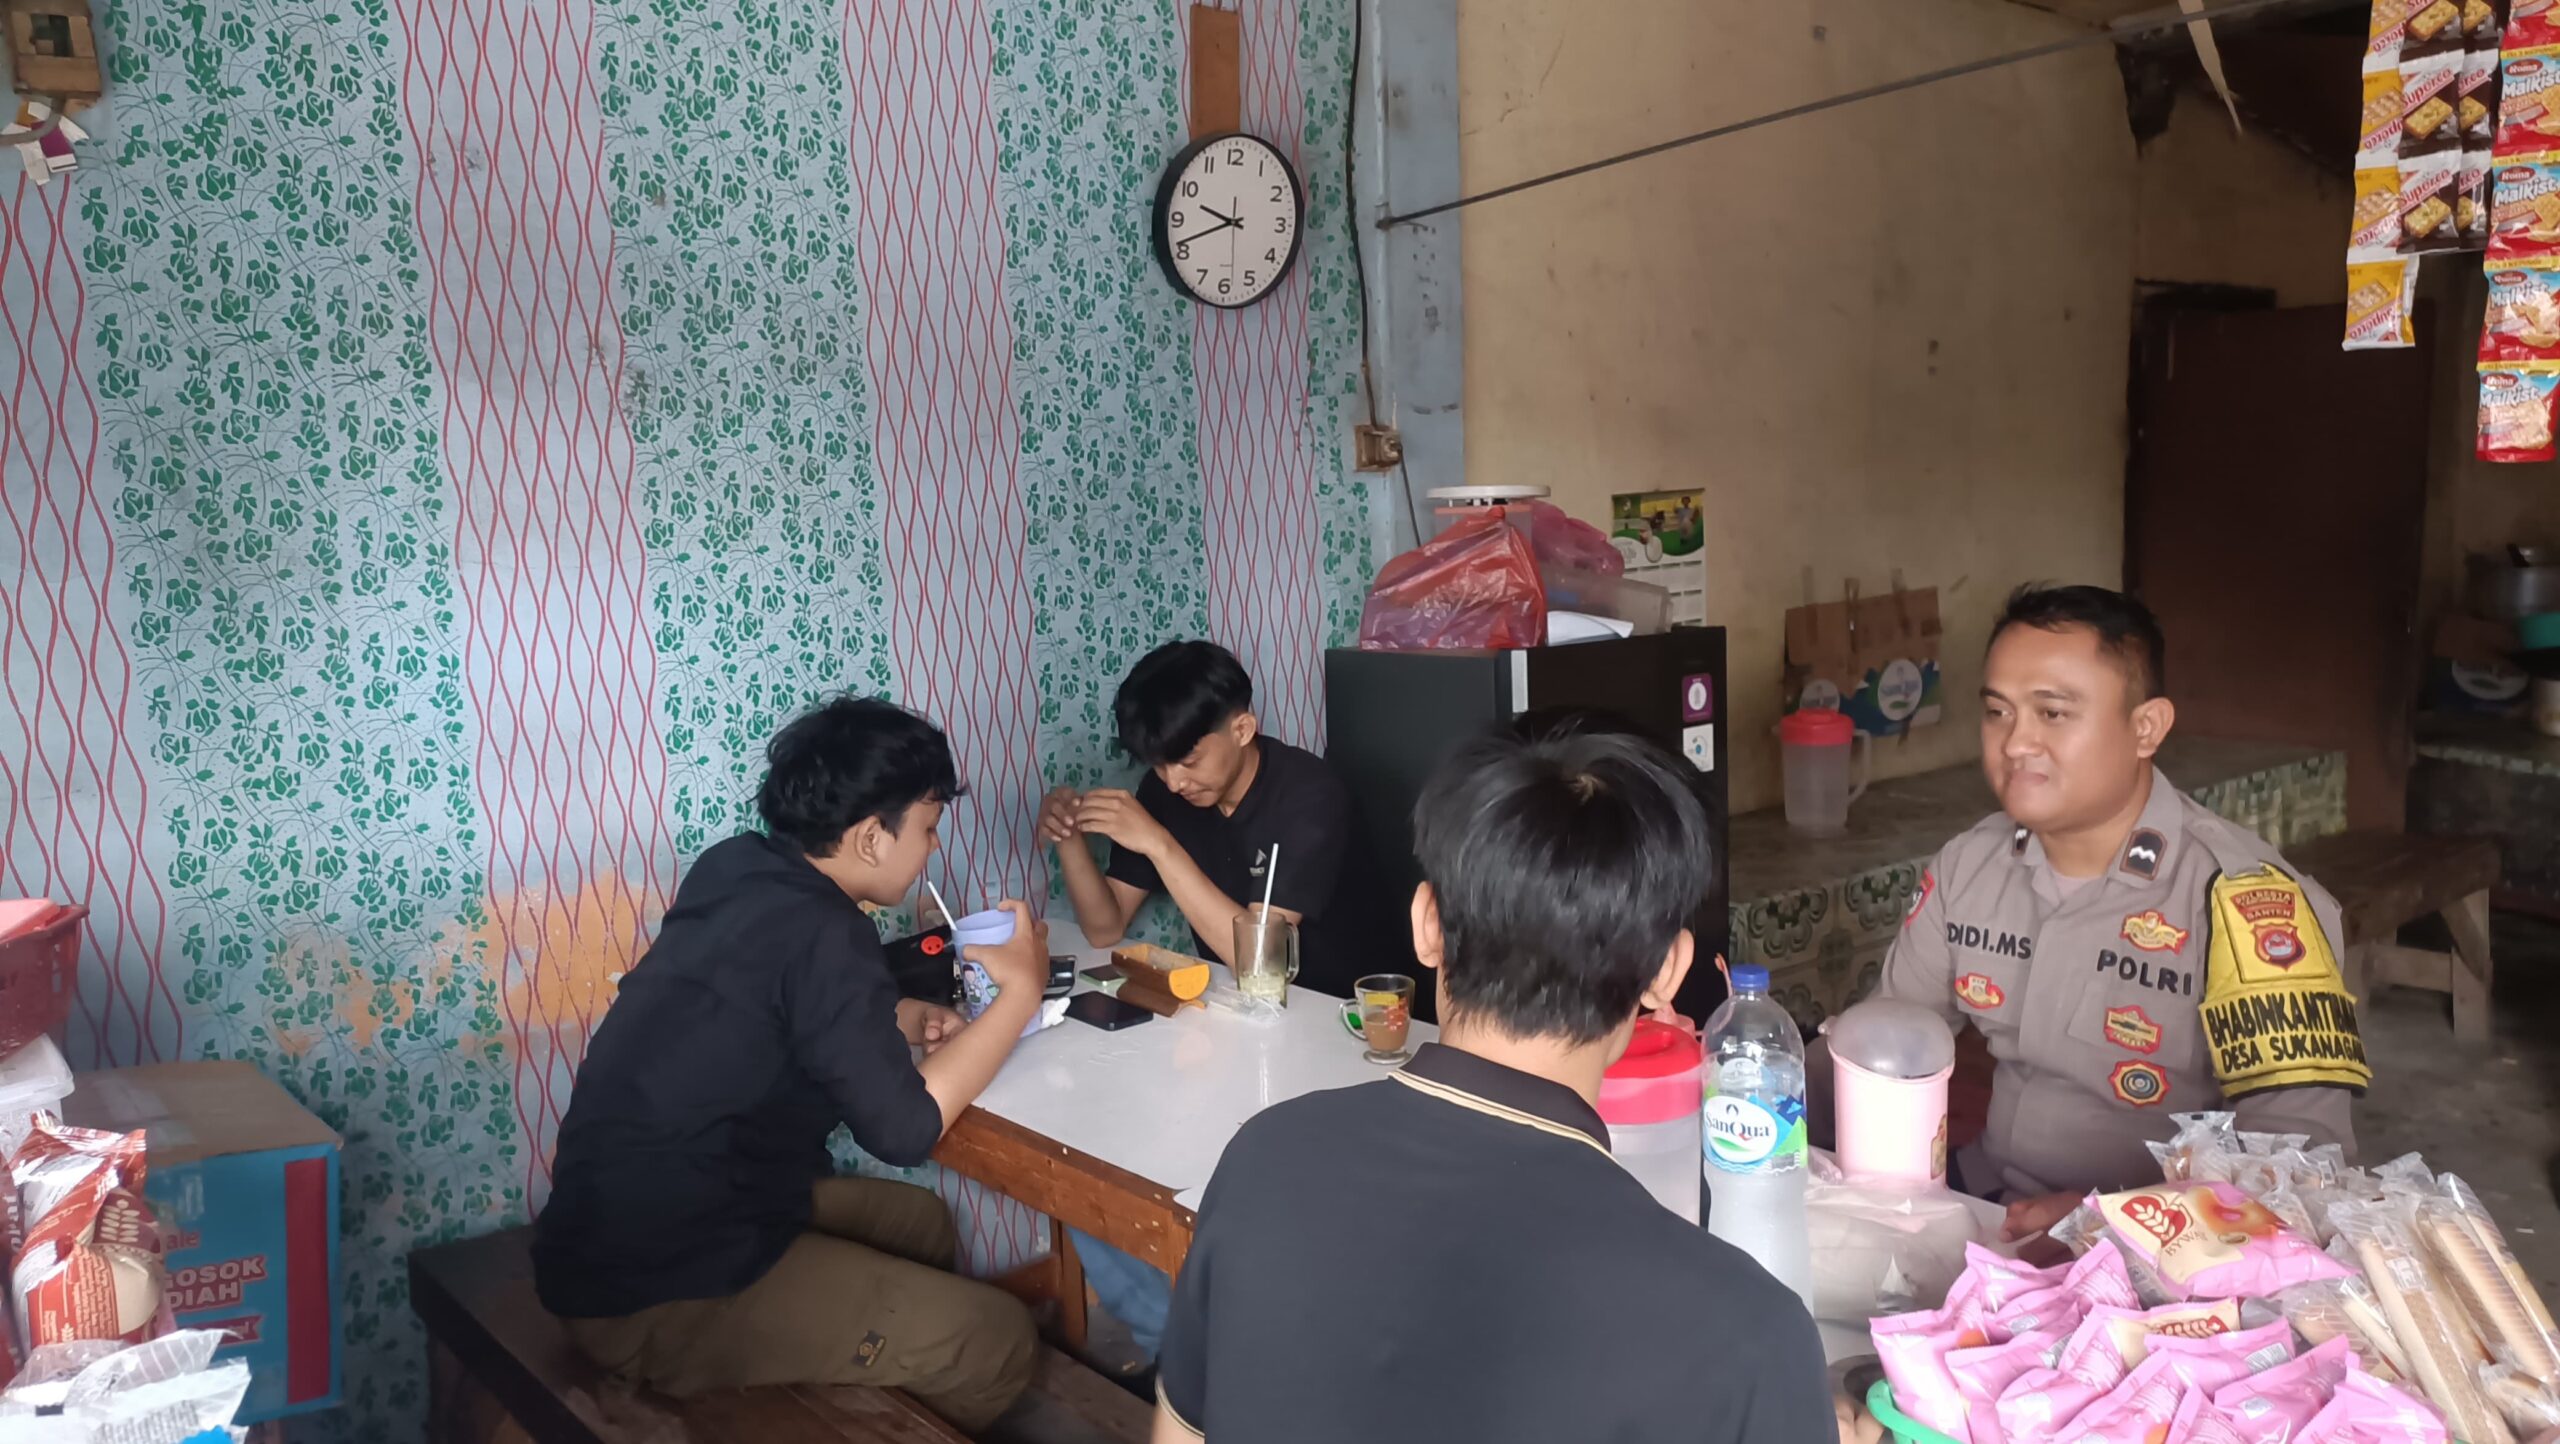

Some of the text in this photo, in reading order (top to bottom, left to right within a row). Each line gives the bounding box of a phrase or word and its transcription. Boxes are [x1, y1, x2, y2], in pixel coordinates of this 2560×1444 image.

[1205, 157, 1215, 174] 11
[1227, 149, 1244, 166] 12
[1258, 160, 1264, 177] 1
[1181, 181, 1199, 198] 10
[1270, 186, 1283, 202] 2
[1171, 211, 1185, 228] 9
[1274, 217, 1286, 233] 3
[1176, 243, 1190, 260] 8
[1264, 248, 1276, 263] 4
[1196, 268, 1209, 285] 7
[1243, 270, 1256, 286] 5
[1218, 278, 1231, 294] 6
[2246, 908, 2291, 920] BANTEN
[1946, 921, 2032, 960] DIDI.MS
[2096, 948, 2192, 996] POLRI
[2221, 1040, 2264, 1074] DESA
[1705, 1112, 1770, 1141] SanQua
[165, 1282, 239, 1309] DIAH
